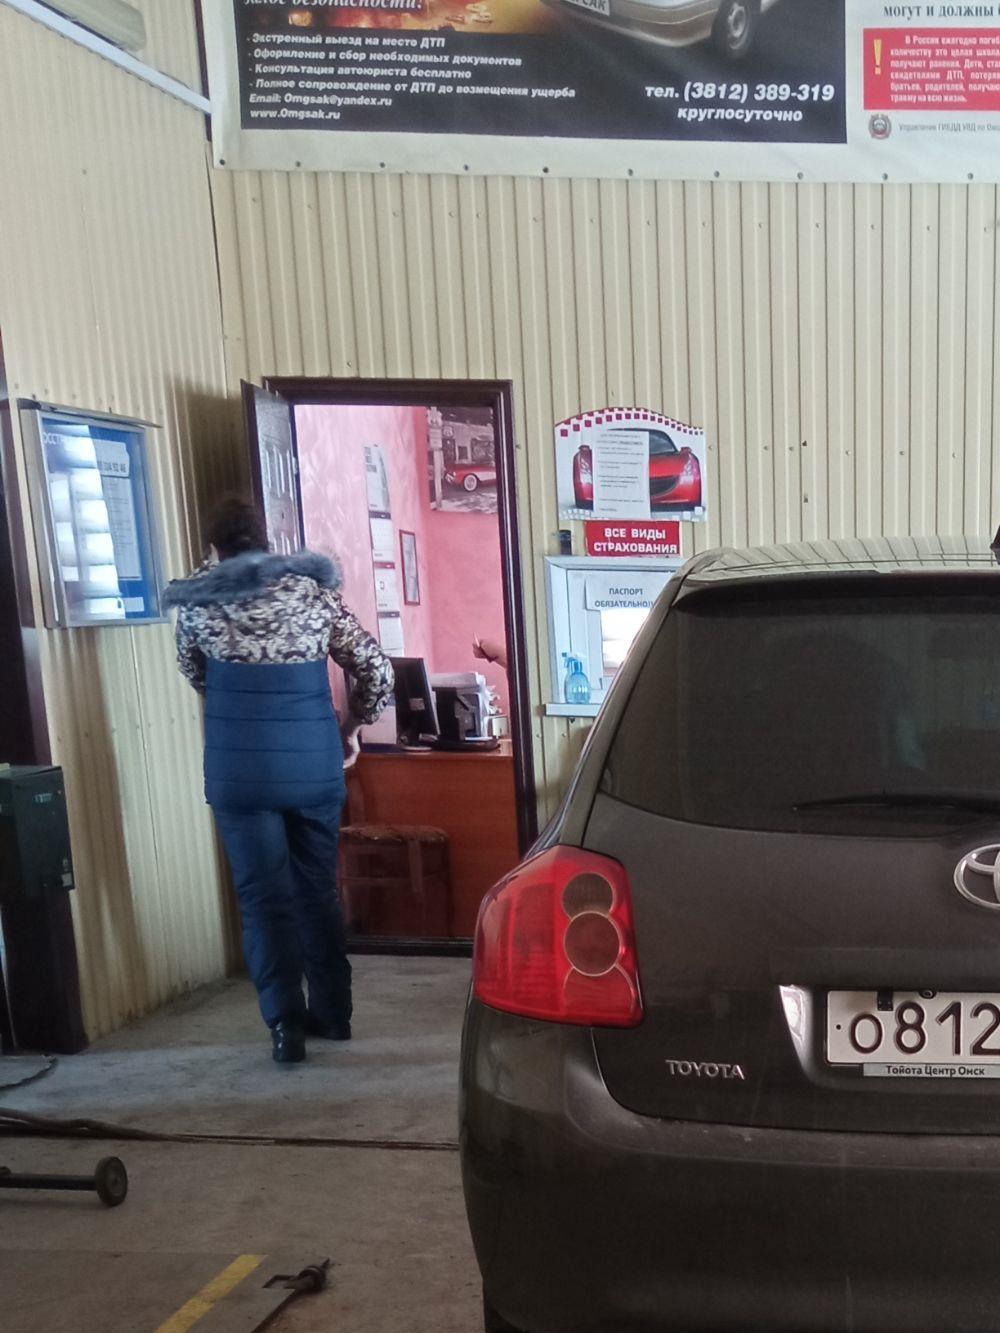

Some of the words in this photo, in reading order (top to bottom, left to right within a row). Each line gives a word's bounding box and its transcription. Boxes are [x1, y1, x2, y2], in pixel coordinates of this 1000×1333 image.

[884, 4, 921, 21] могут
[927, 5, 934, 16] и
[938, 4, 993, 19] должны
[252, 33, 322, 44] Экстренный
[325, 36, 362, 46] выезд
[365, 38, 379, 46] на
[382, 38, 417, 47] место
[420, 38, 445, 48] ДТП
[254, 49, 325, 60] Оформление
[340, 50, 366, 61] сбор
[370, 52, 449, 64] необходимых
[452, 55, 522, 66] документов
[255, 64, 334, 75] Консультация
[338, 66, 407, 78] автоюриста
[410, 68, 471, 78] бесплатно
[256, 78, 295, 88] Полное
[298, 80, 390, 92] сопровождение
[394, 84, 408, 92] от
[410, 82, 435, 93] ДТП
[438, 85, 453, 94] до
[456, 85, 528, 97] возмещения
[531, 86, 576, 98] ущерба
[645, 86, 679, 98] тел.
[684, 82, 748, 103] (3812)
[754, 84, 835, 101] 389-319
[250, 93, 281, 103] Email:
[250, 108, 341, 120] www.Omgsak.ru
[677, 107, 803, 122] круглосуточно
[605, 528, 626, 538] ВСЕ
[632, 528, 666, 540] ВИДЫ
[594, 542, 677, 553] СТРАХОВАНИЯ
[665, 1060, 744, 1080] TOYOTA
[886, 1065, 924, 1076] Тойота
[926, 1066, 956, 1078] Центр
[958, 1066, 985, 1076] Омск
